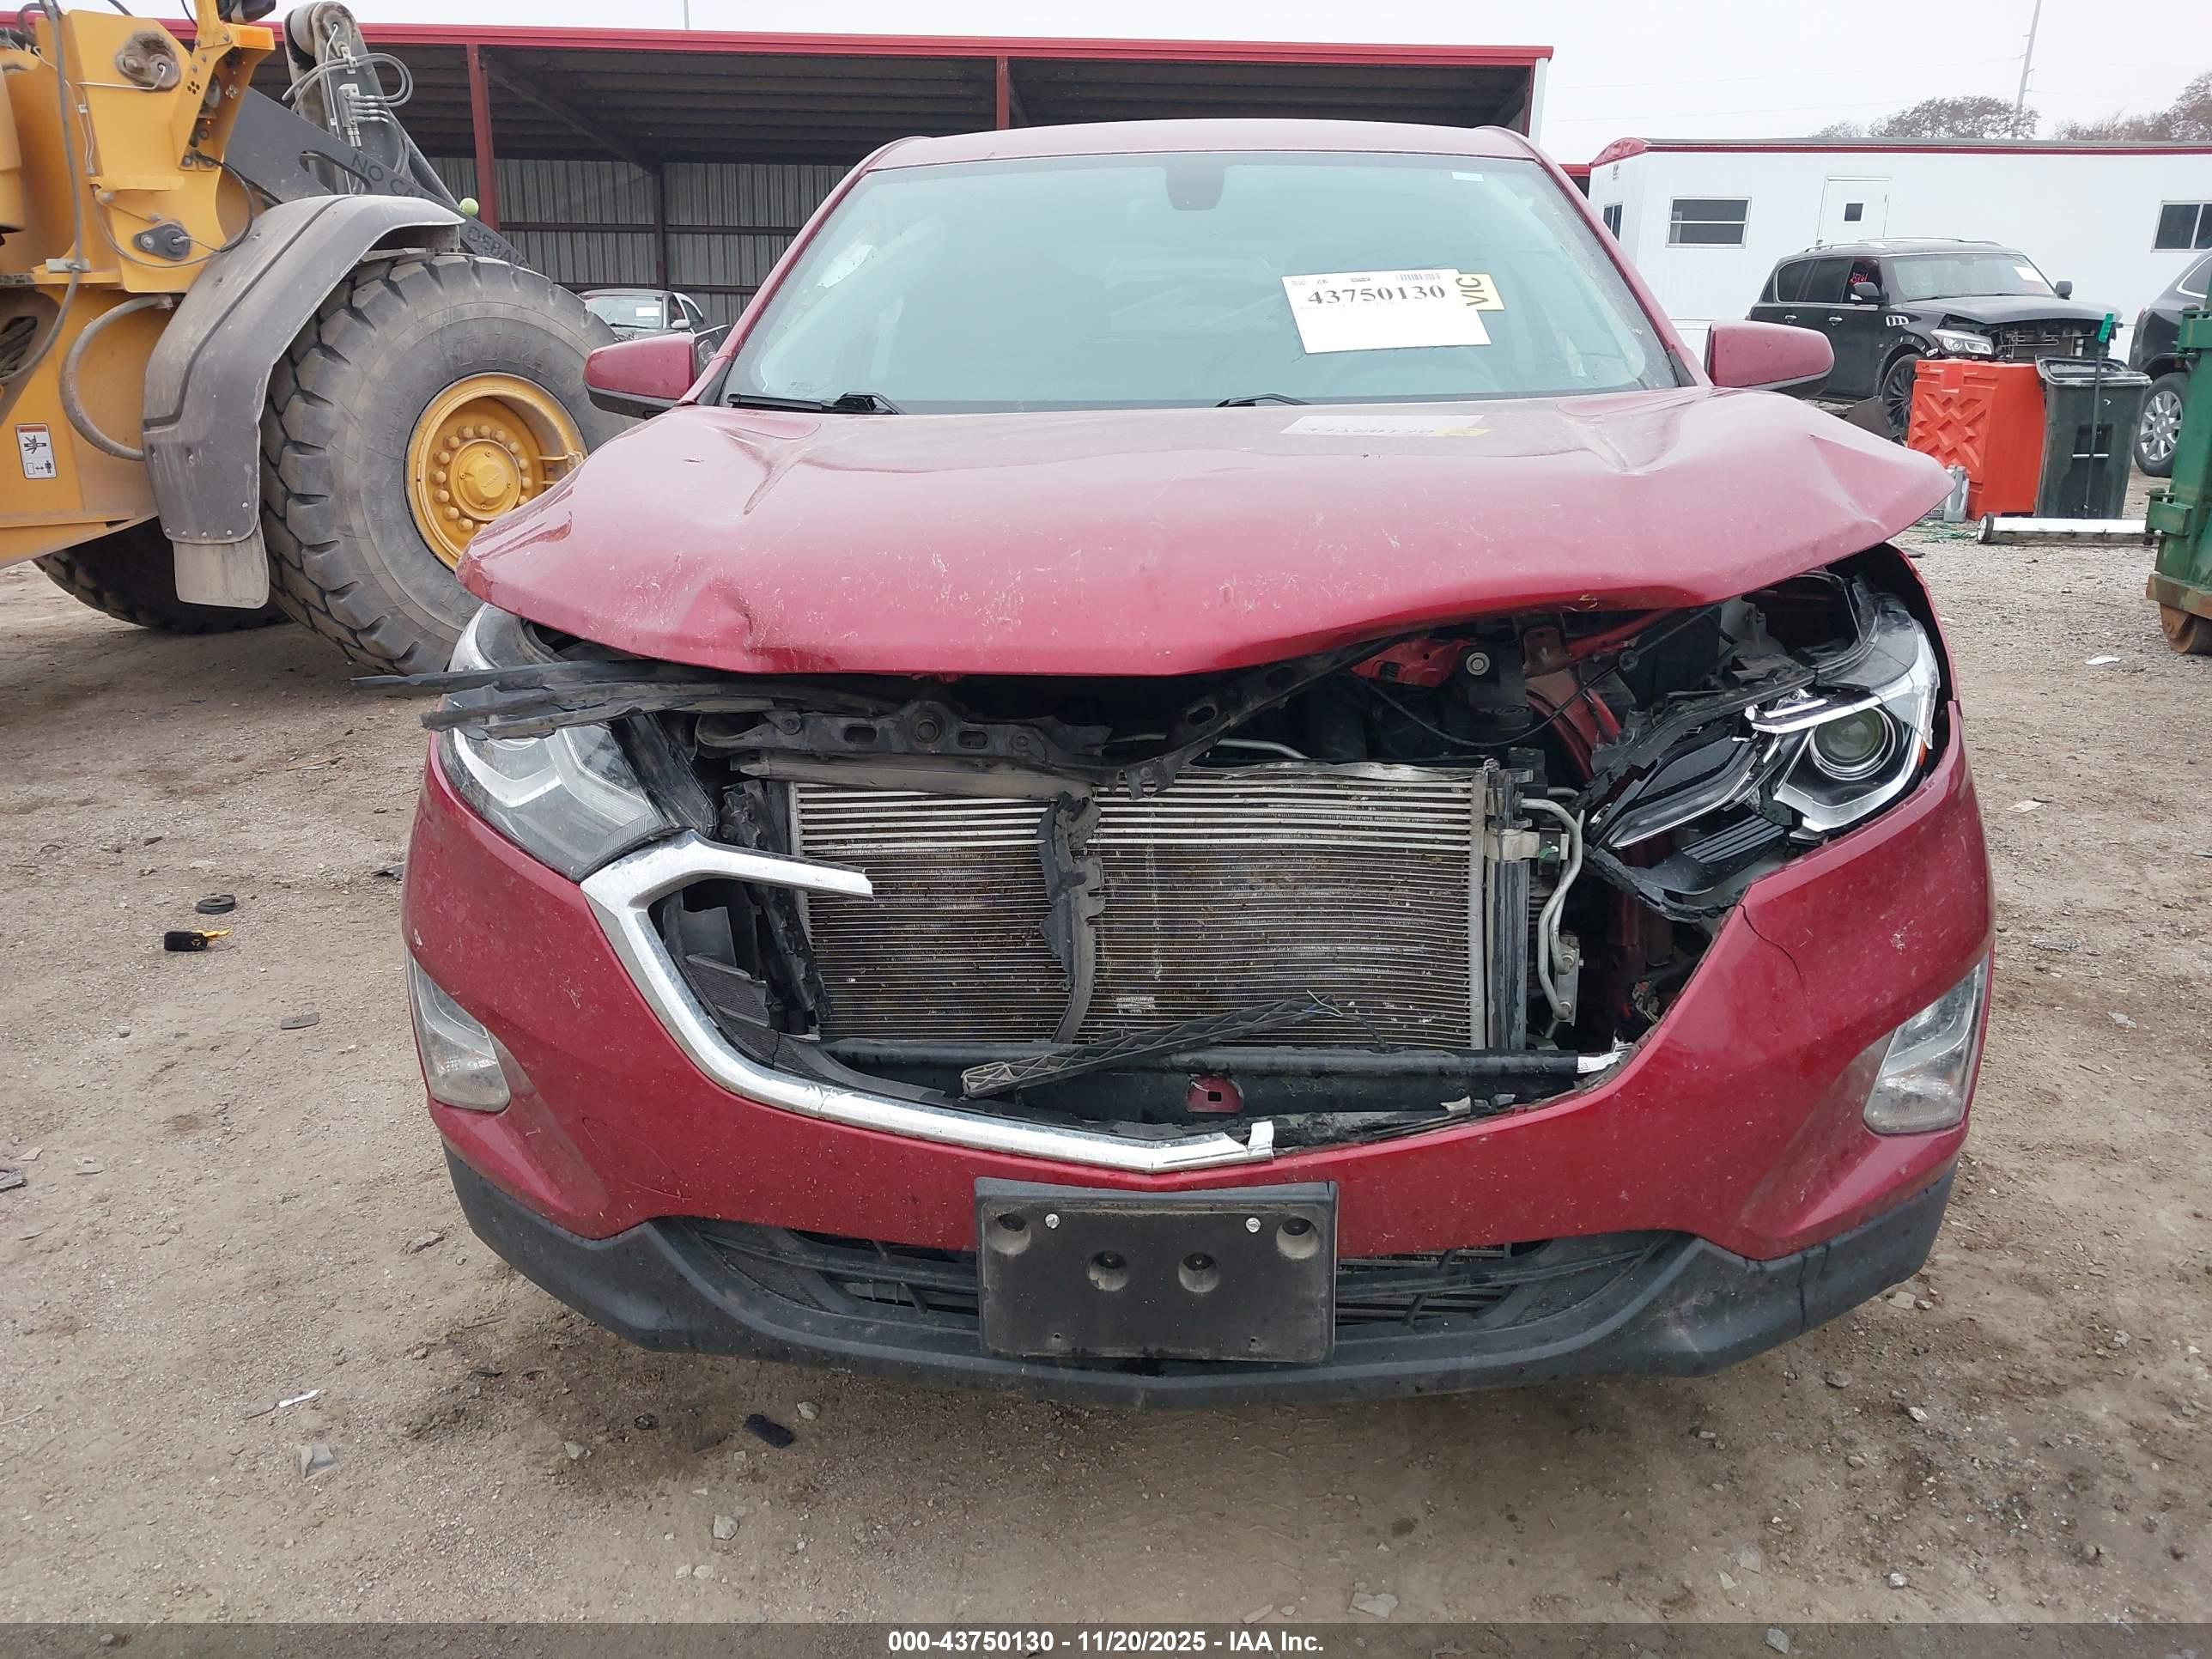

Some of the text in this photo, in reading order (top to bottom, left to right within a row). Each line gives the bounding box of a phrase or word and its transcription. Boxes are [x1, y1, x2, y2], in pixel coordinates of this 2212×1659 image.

[351, 152, 384, 182] NO
[1308, 284, 1446, 305] 43750130
[1455, 276, 1489, 307] VIC
